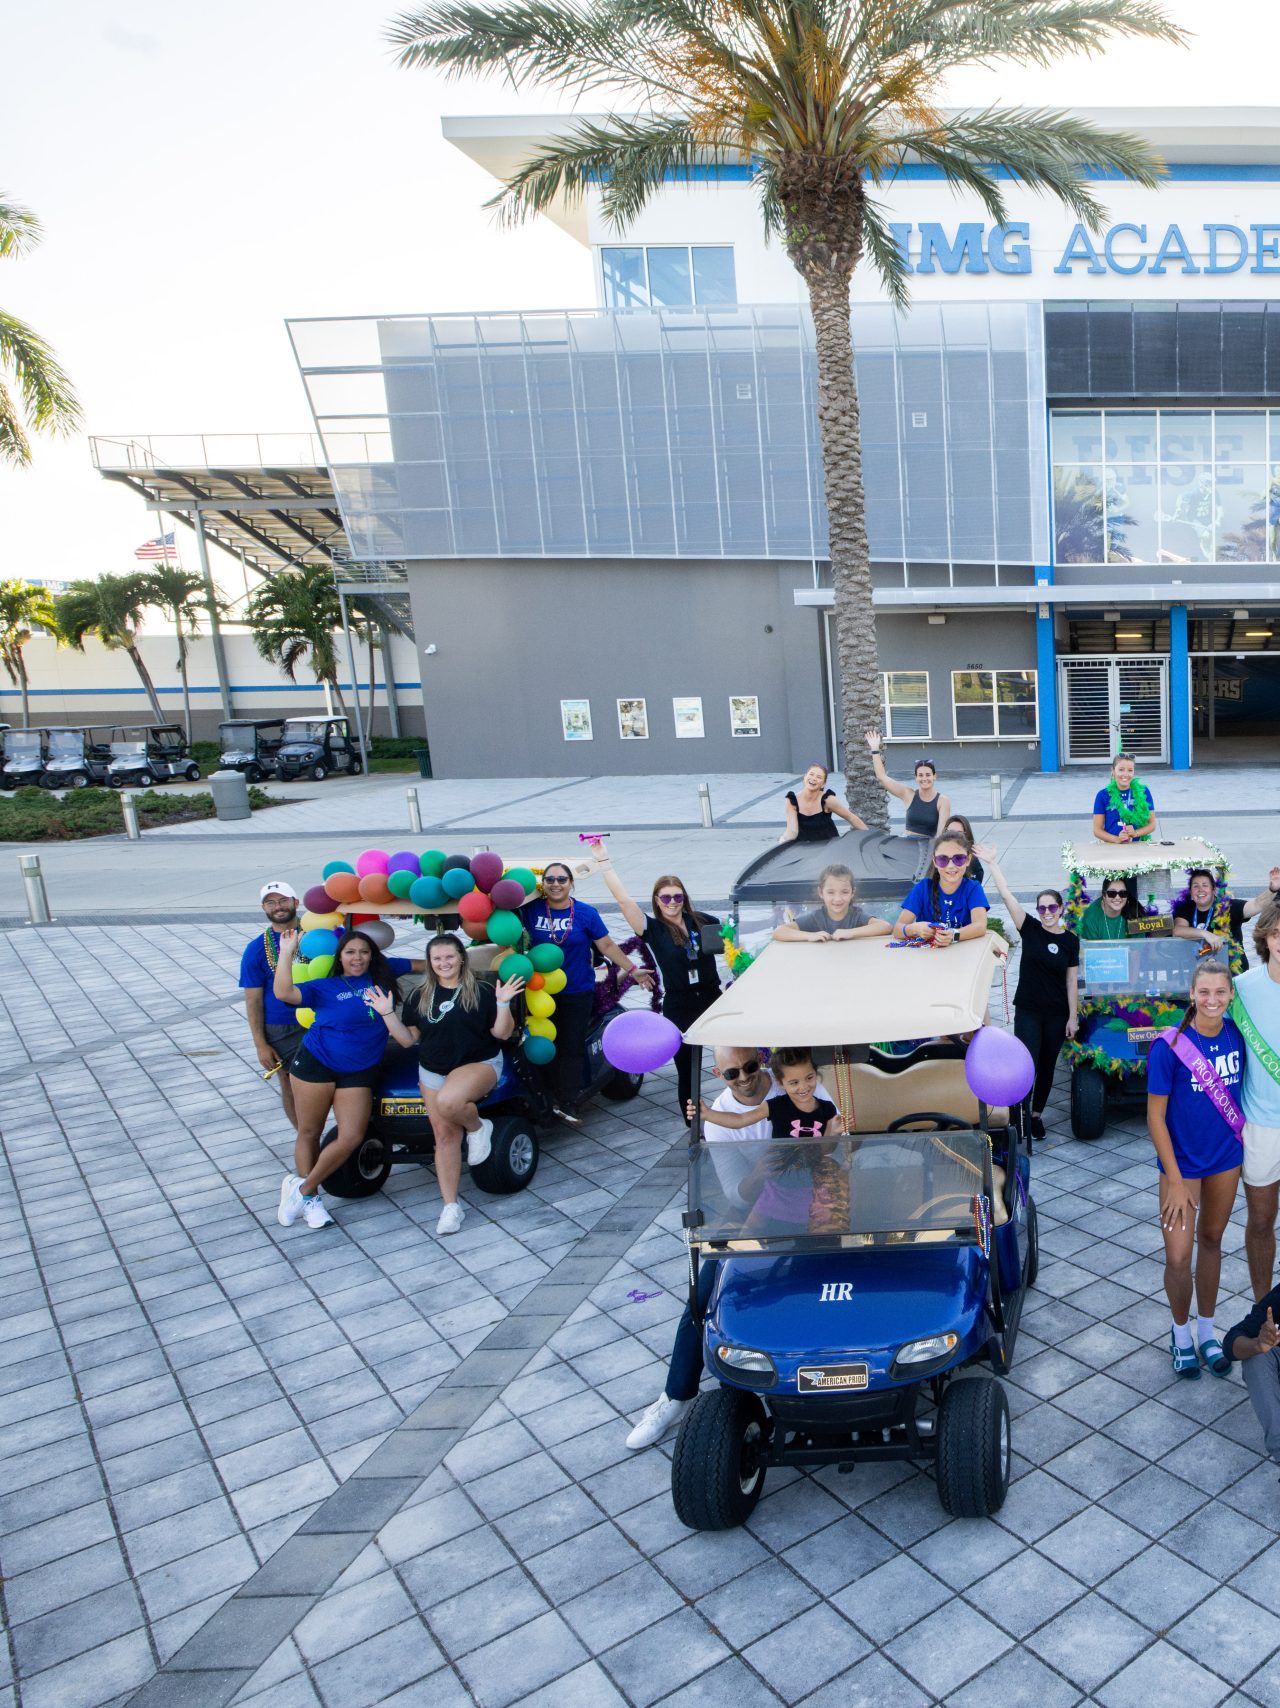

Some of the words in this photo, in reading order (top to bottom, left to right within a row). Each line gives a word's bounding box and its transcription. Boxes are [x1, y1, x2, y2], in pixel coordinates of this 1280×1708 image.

[888, 222, 1032, 274] IMG
[966, 663, 984, 671] 5650
[535, 916, 573, 931] IMG
[1138, 918, 1165, 931] Royal
[1128, 1031, 1145, 1041] New
[1241, 1020, 1265, 1055] PROM
[1191, 1050, 1240, 1083] MG
[1191, 1057, 1219, 1089] PROM
[1213, 1088, 1239, 1124] COURT
[819, 1282, 854, 1302] HR
[817, 1375, 848, 1387] AMERICAN
[848, 1374, 866, 1385] PRIDE
